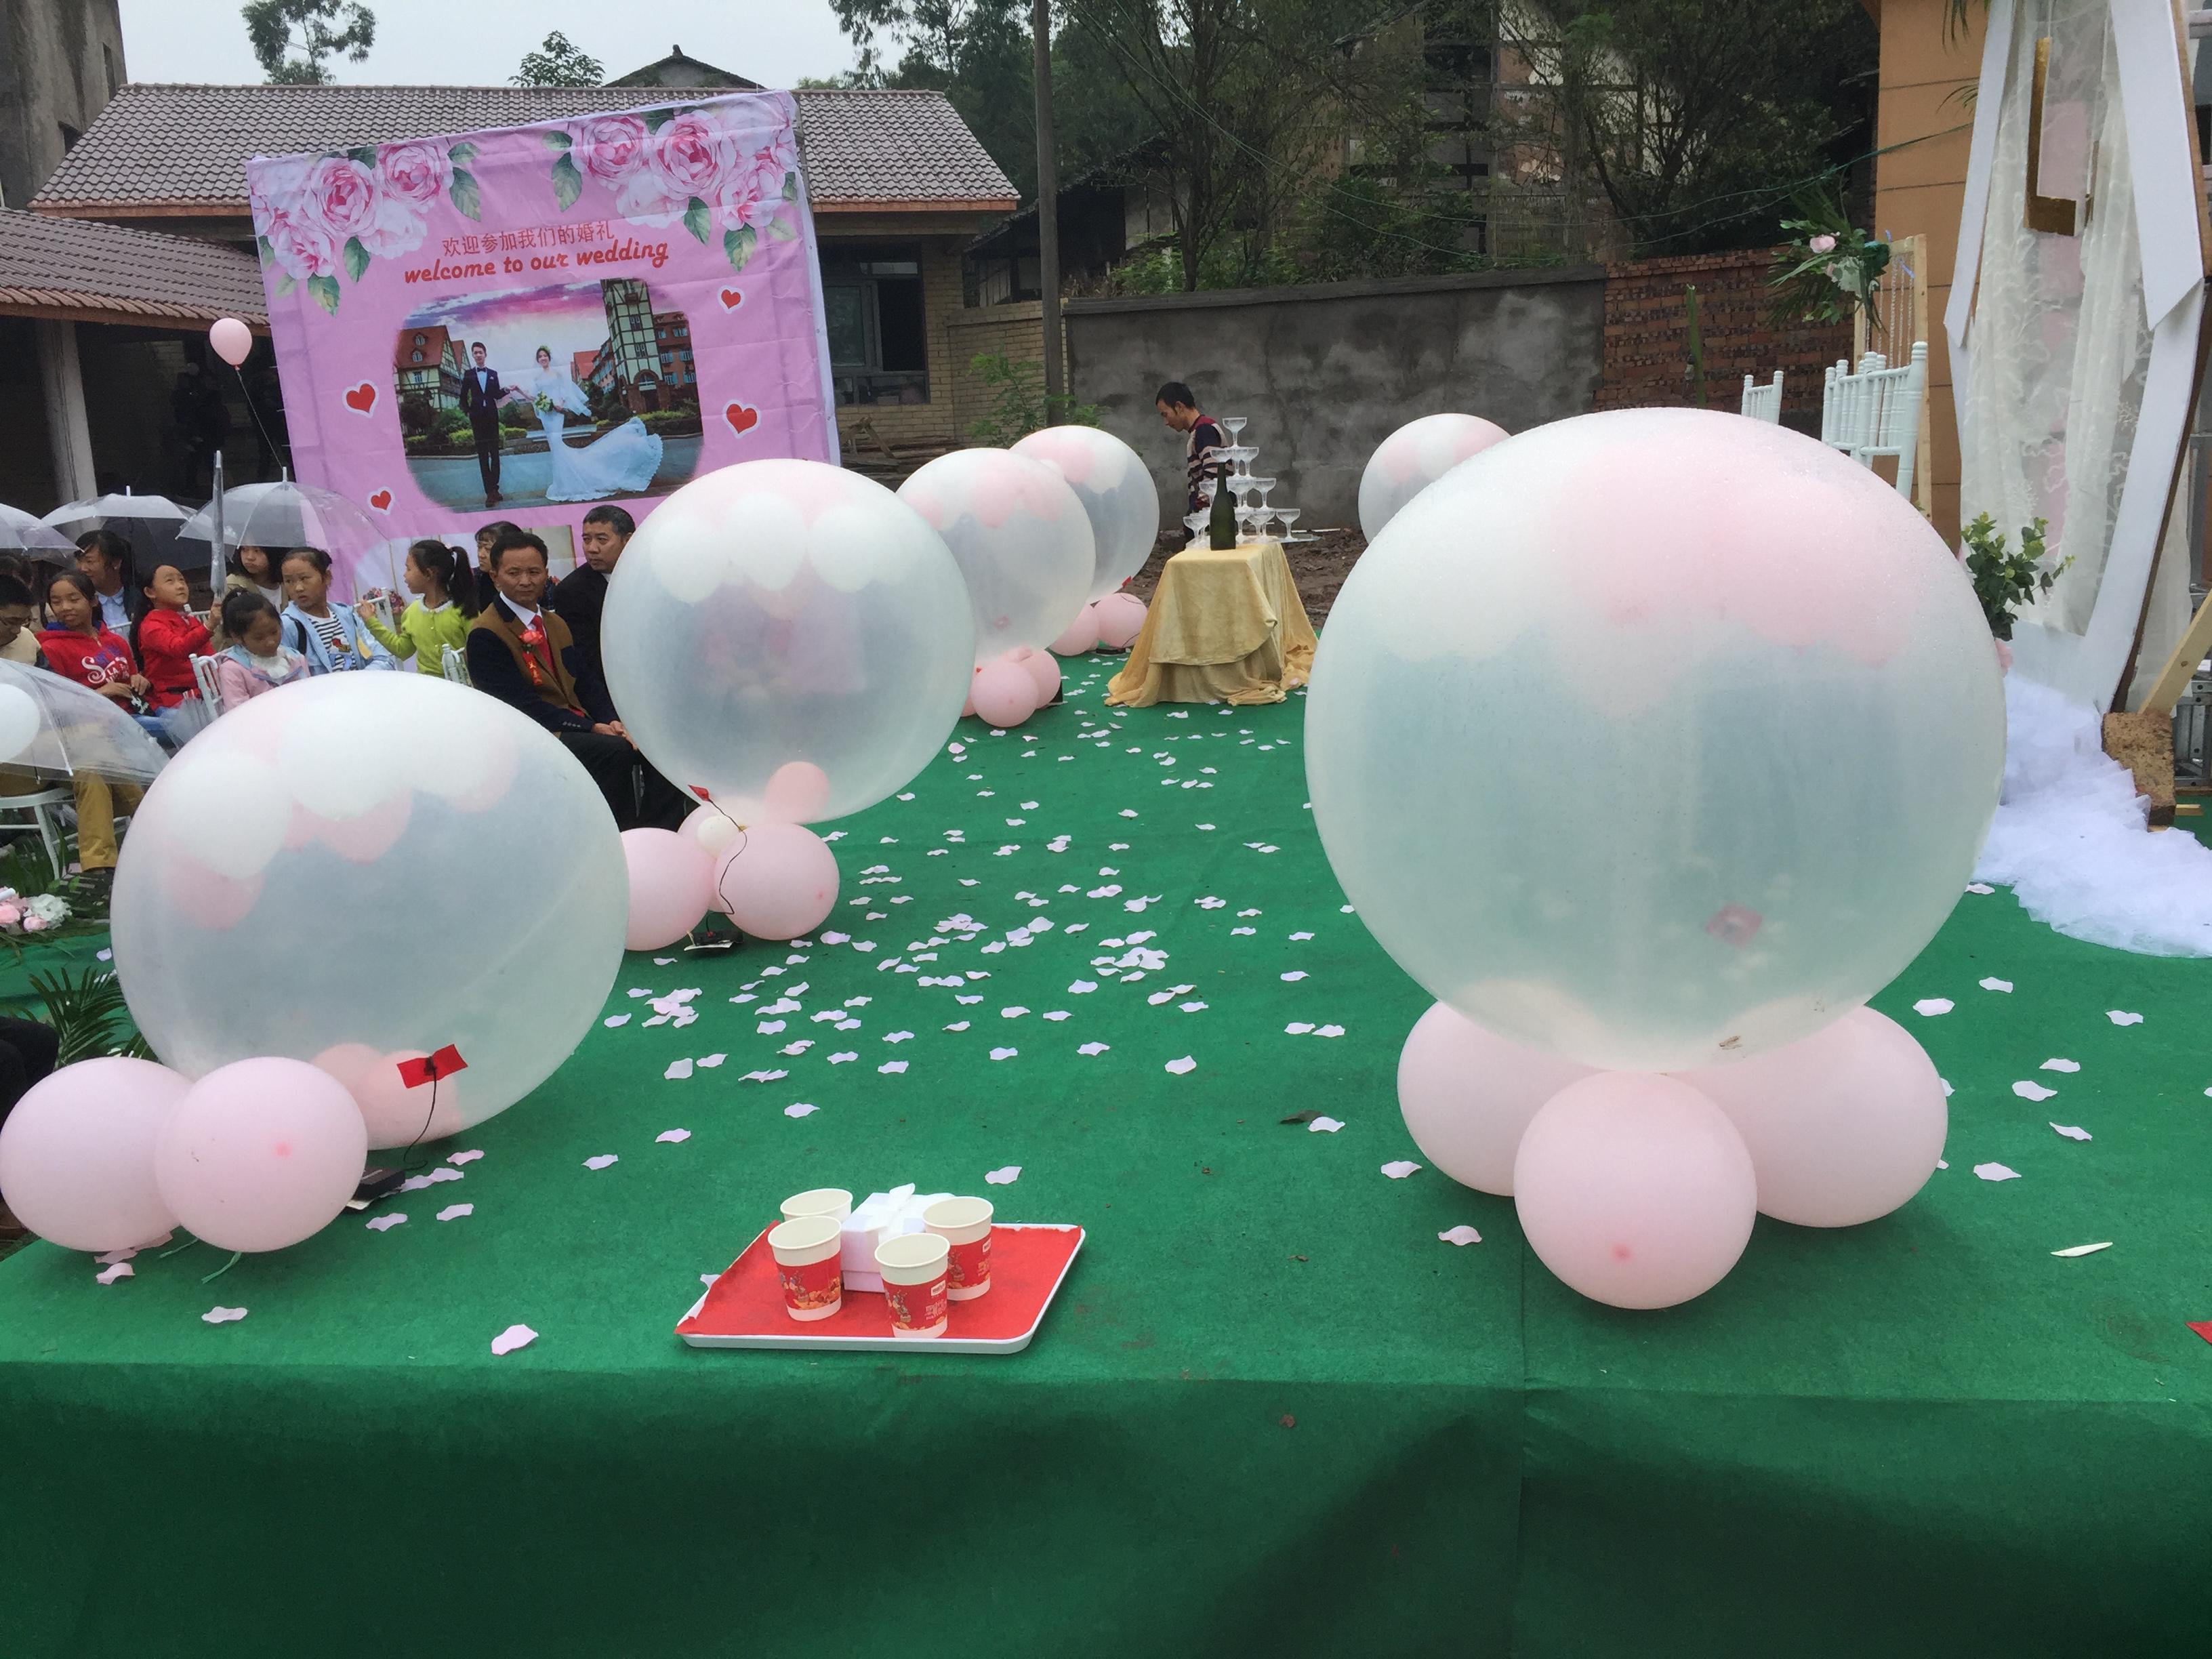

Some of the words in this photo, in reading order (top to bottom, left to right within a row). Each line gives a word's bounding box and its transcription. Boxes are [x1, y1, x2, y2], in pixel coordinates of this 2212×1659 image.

[443, 222, 614, 257] 欢迎参加我们的婚礼
[405, 260, 495, 283] welcome
[504, 257, 523, 273] to
[531, 253, 569, 270] our
[577, 238, 668, 268] wedding
